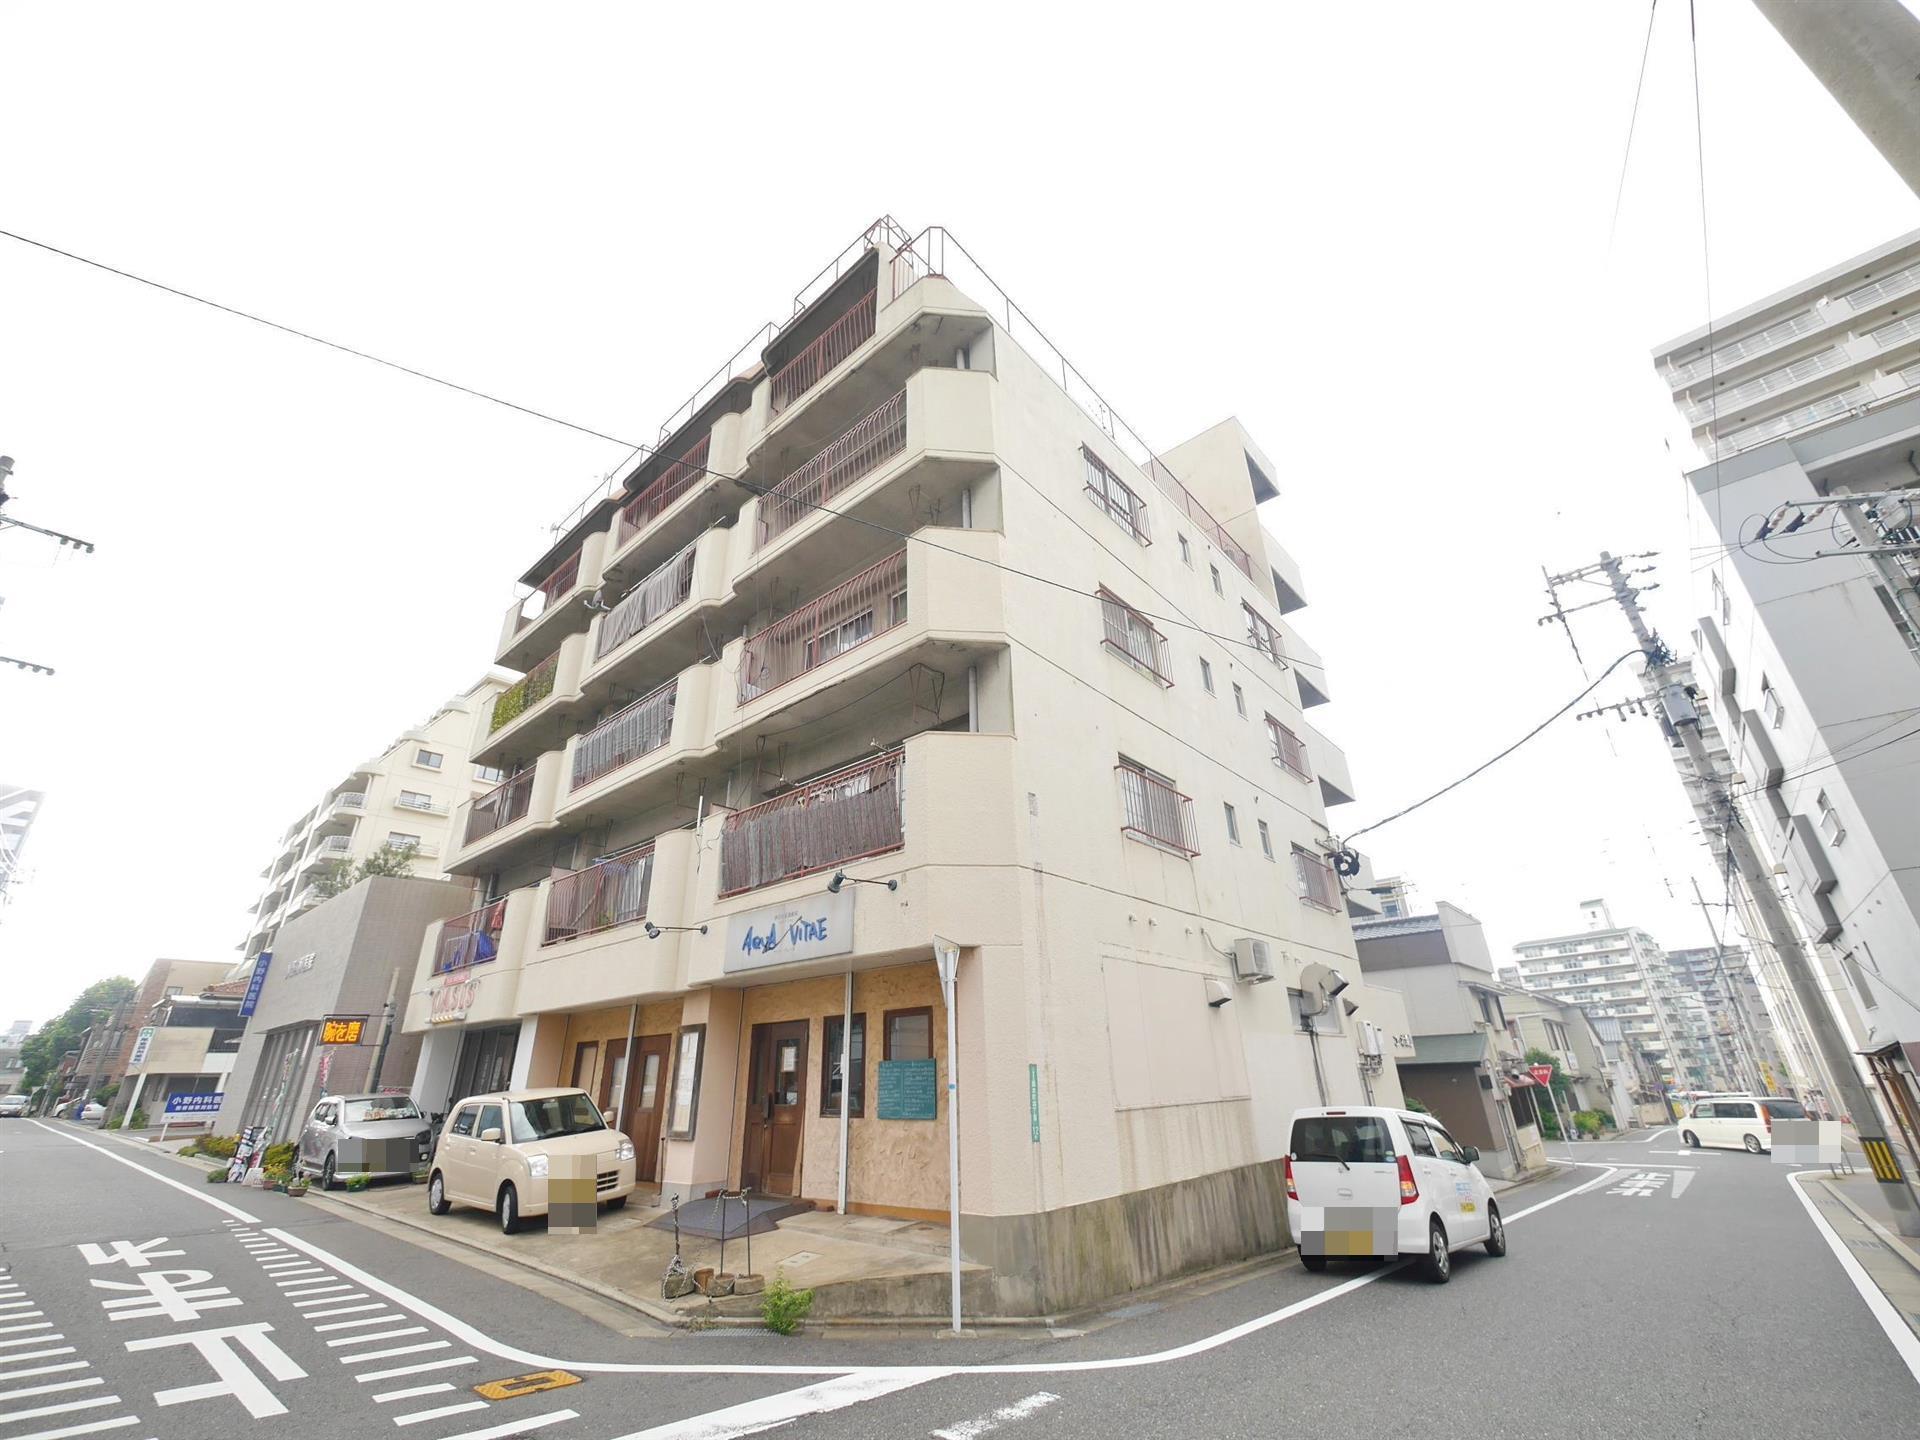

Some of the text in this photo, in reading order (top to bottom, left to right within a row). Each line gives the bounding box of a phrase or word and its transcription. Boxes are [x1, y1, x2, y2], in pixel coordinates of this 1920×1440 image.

[244, 959, 268, 1009] 小野内科医院
[1606, 1172, 1671, 1197] 止まれ
